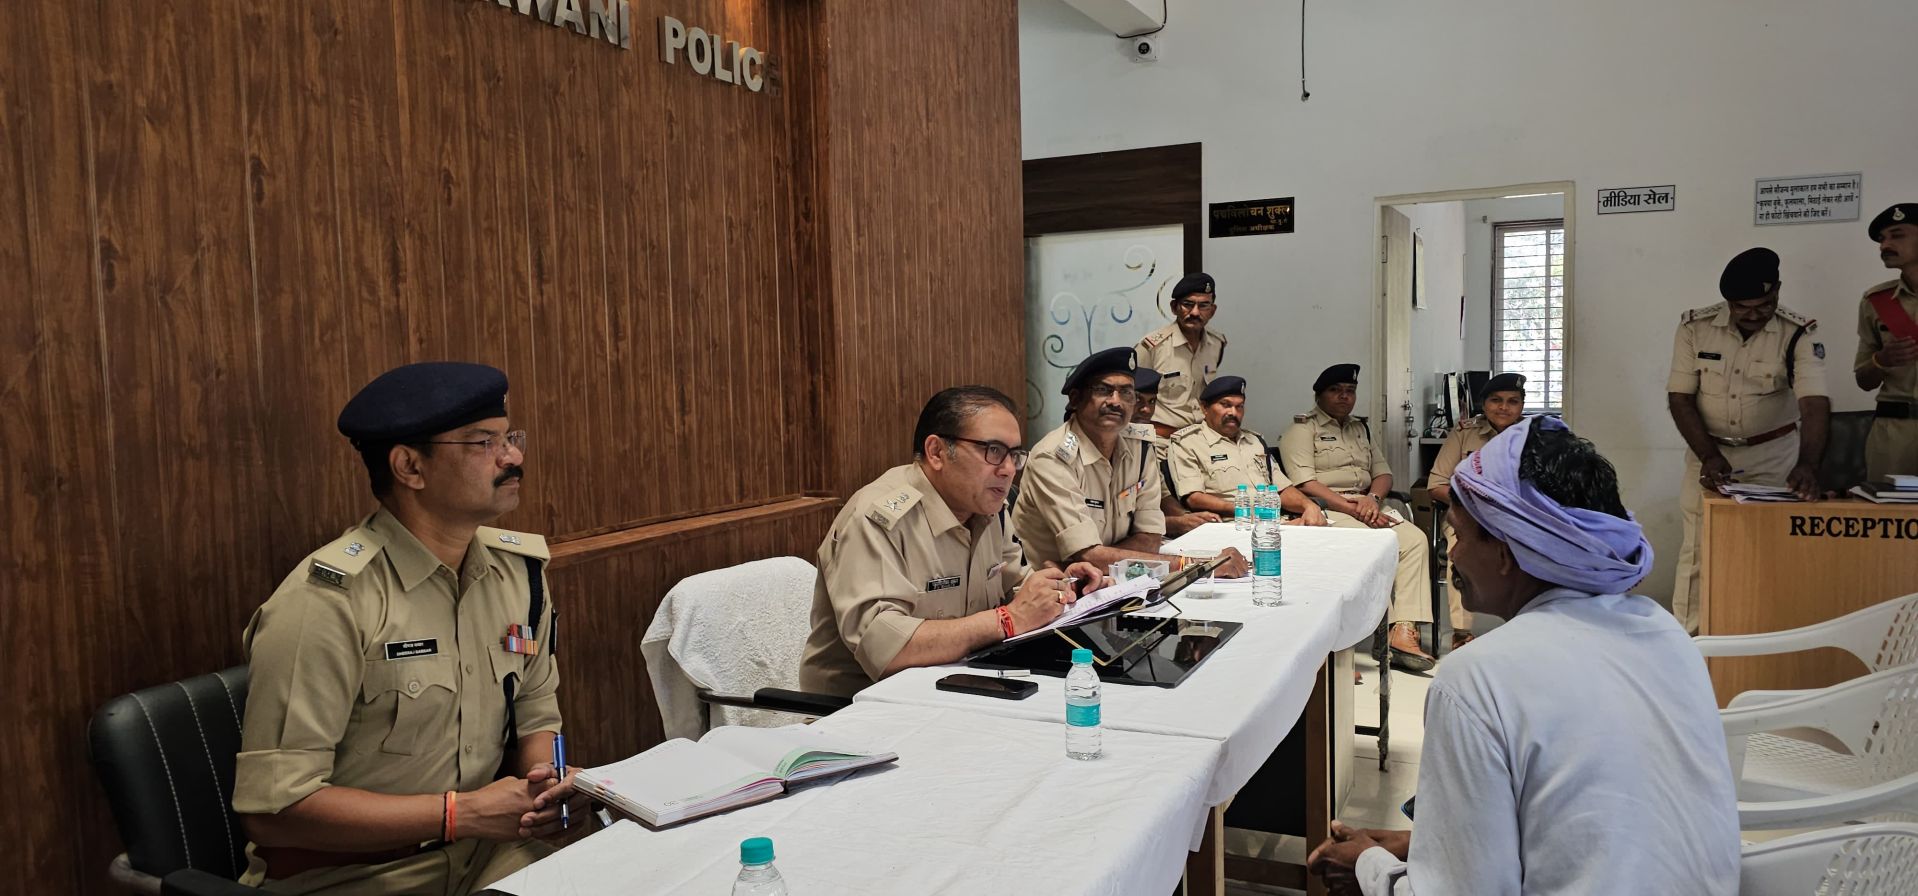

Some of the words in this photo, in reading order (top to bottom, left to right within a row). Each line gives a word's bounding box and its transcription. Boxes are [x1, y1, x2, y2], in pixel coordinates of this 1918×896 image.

[498, 0, 631, 50] ANI
[1602, 191, 1641, 207] मीडिया
[1643, 189, 1670, 204] सेल
[1789, 515, 1918, 540] RECEPTIO
